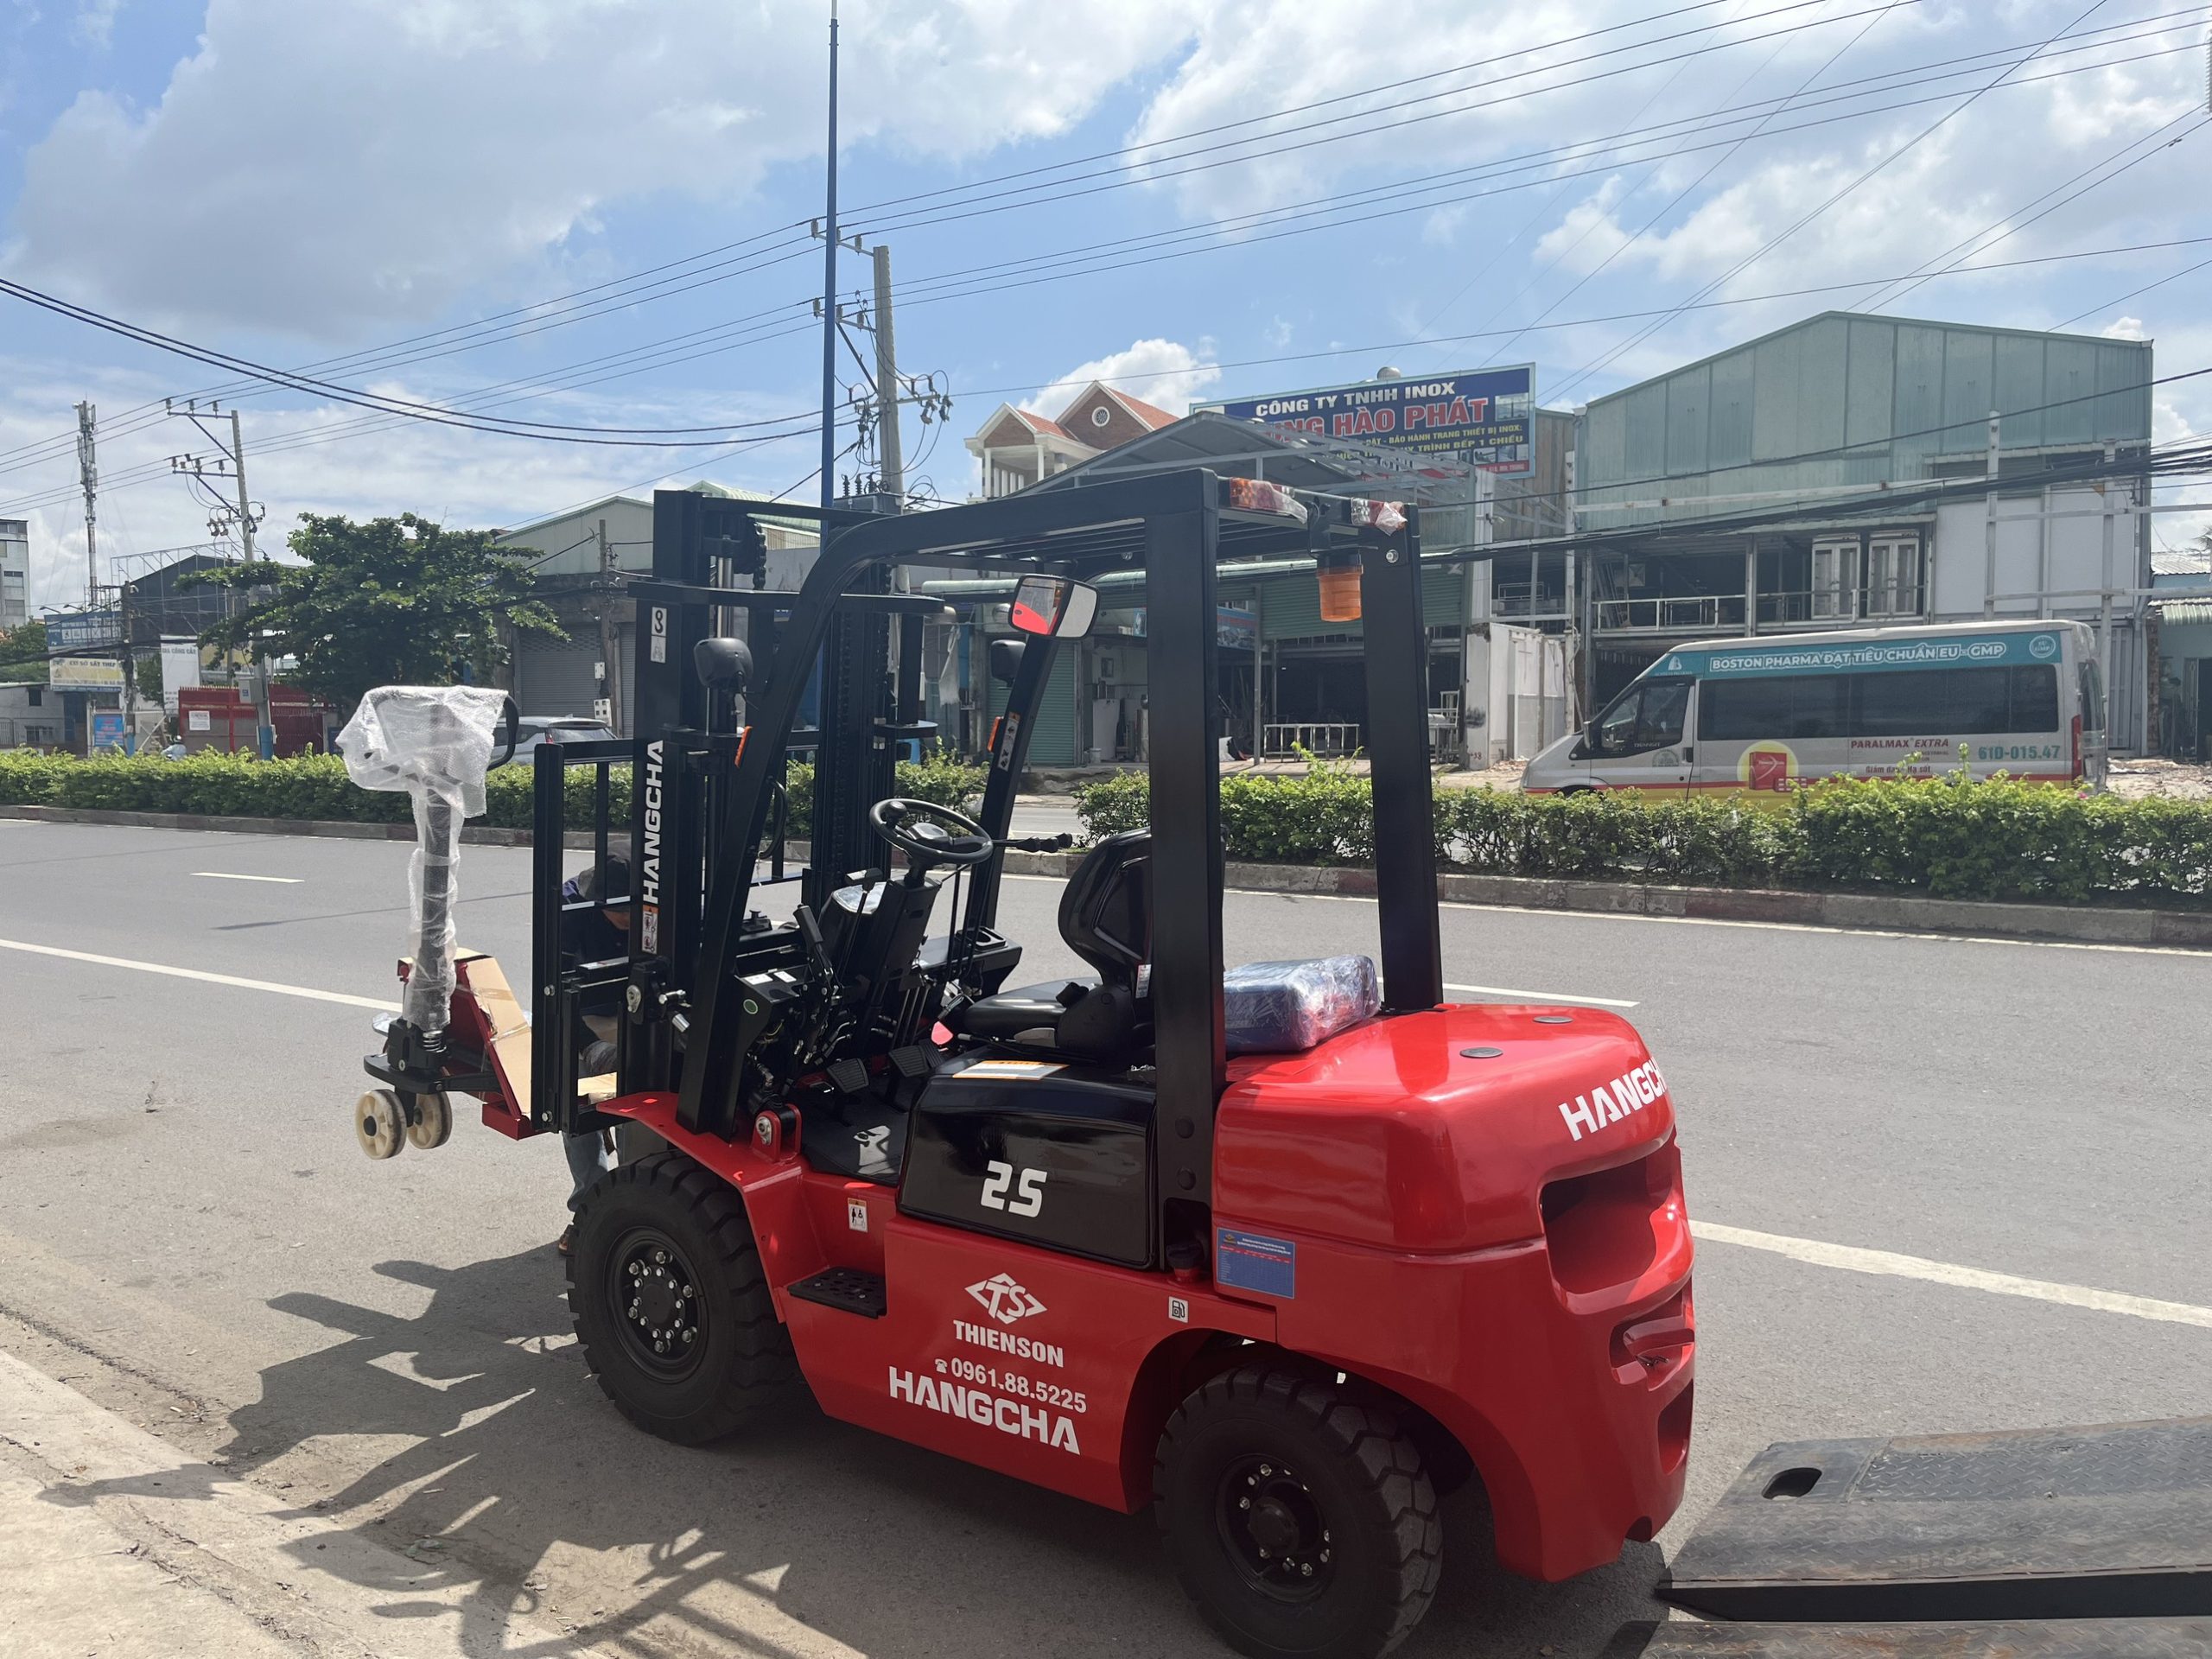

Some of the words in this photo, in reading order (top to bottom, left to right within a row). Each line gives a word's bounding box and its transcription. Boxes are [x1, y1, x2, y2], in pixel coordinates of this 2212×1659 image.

[1255, 400, 1309, 416] CÔNG
[1314, 395, 1338, 410] TY
[1344, 388, 1398, 406] TNHH
[1404, 382, 1456, 399] INOX
[1332, 406, 1395, 437] HÀO
[1404, 395, 1489, 430] PHÁT
[1433, 430, 1460, 440] TRANG
[1478, 438, 1485, 447] 1
[1712, 657, 1763, 670] BOSTON
[1765, 654, 1821, 667] PHARMA
[1823, 652, 1850, 665] ĐẠT
[1853, 648, 1884, 663] TIÊU
[1970, 645, 2004, 657] GMP
[1851, 739, 1909, 749] PARALMAX
[1914, 738, 1949, 747] EXTRA
[1978, 745, 2061, 760] 61D-015.47
[643, 740, 664, 905] HANGCHA
[980, 1160, 1048, 1218] 25
[953, 1319, 1065, 1368] THIENSON
[950, 1357, 1087, 1414] 0961.88.5225
[888, 1365, 1080, 1456] HANGCHA
